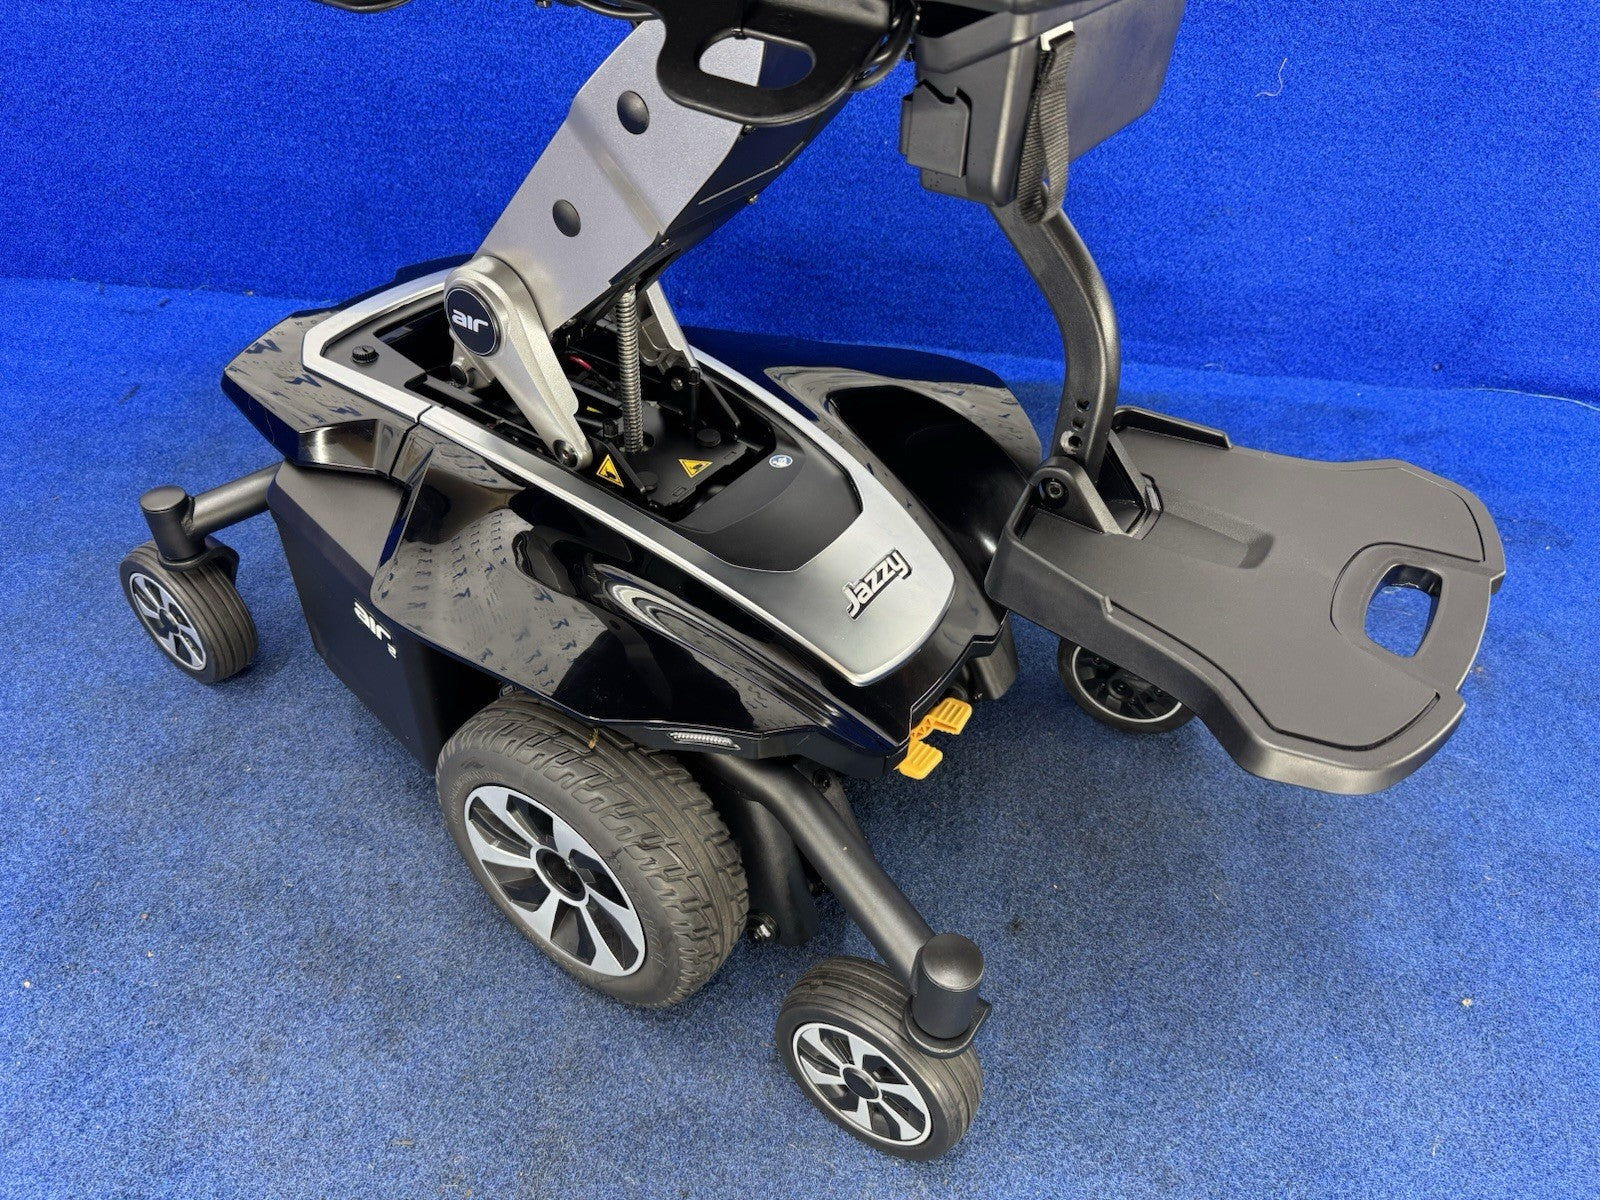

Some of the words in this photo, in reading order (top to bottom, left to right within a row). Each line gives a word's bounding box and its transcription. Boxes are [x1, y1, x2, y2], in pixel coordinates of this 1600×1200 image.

[451, 309, 489, 333] air
[844, 550, 912, 620] Jazzy
[353, 601, 392, 641] air
